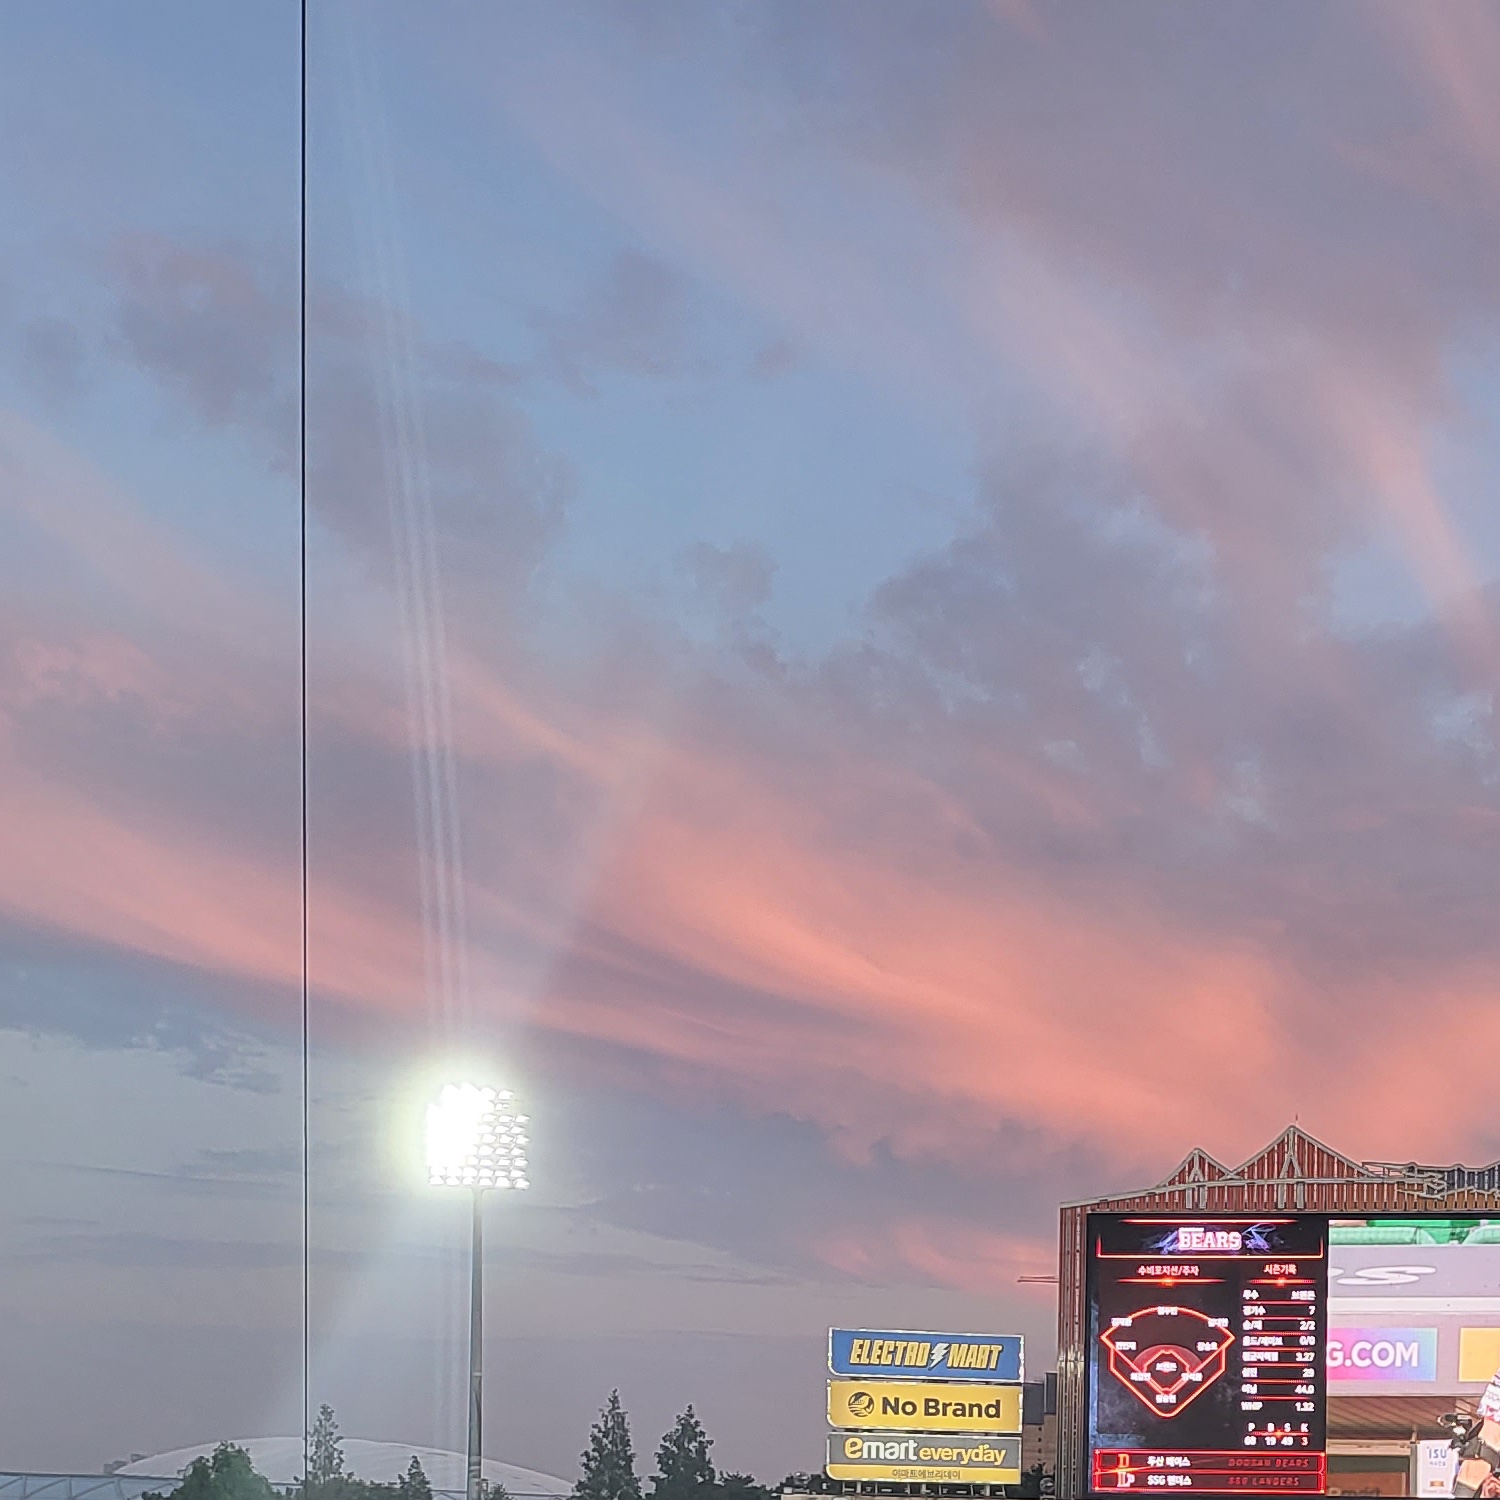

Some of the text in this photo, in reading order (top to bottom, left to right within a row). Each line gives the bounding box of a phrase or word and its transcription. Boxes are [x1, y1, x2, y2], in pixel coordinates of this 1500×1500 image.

[1179, 1231, 1241, 1250] BEARS
[1308, 1305, 1316, 1316] 7
[849, 1338, 1003, 1369] ELECTRO MART
[881, 1396, 1001, 1418] No Brand
[1300, 1423, 1309, 1433] K
[1300, 1436, 1309, 1446] 3
[844, 1437, 1006, 1466] emart everyday
[1428, 1448, 1448, 1459] ISU
[891, 1468, 961, 1481] 이마트에브리데이
[1147, 1475, 1166, 1486] SSG
